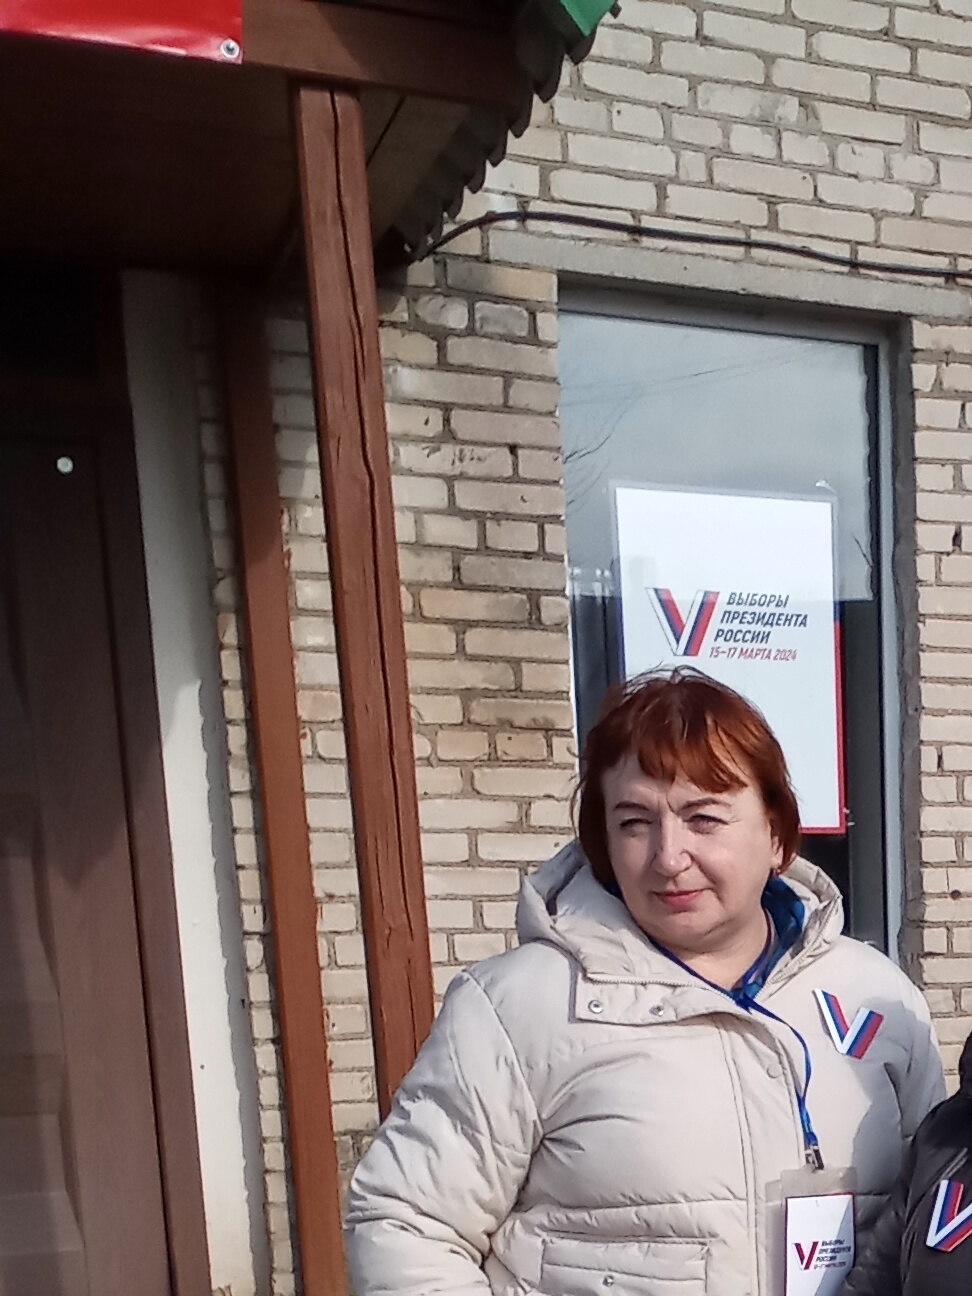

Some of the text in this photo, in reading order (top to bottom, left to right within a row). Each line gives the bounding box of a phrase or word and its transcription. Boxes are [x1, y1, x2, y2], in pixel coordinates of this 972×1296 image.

[726, 592, 790, 609] ВЫБОРЫ
[720, 611, 808, 628] ПРЕЗИДЕНТА
[714, 629, 771, 644] РОССИИ
[738, 648, 772, 661] МАРТА
[773, 649, 798, 661] 2024
